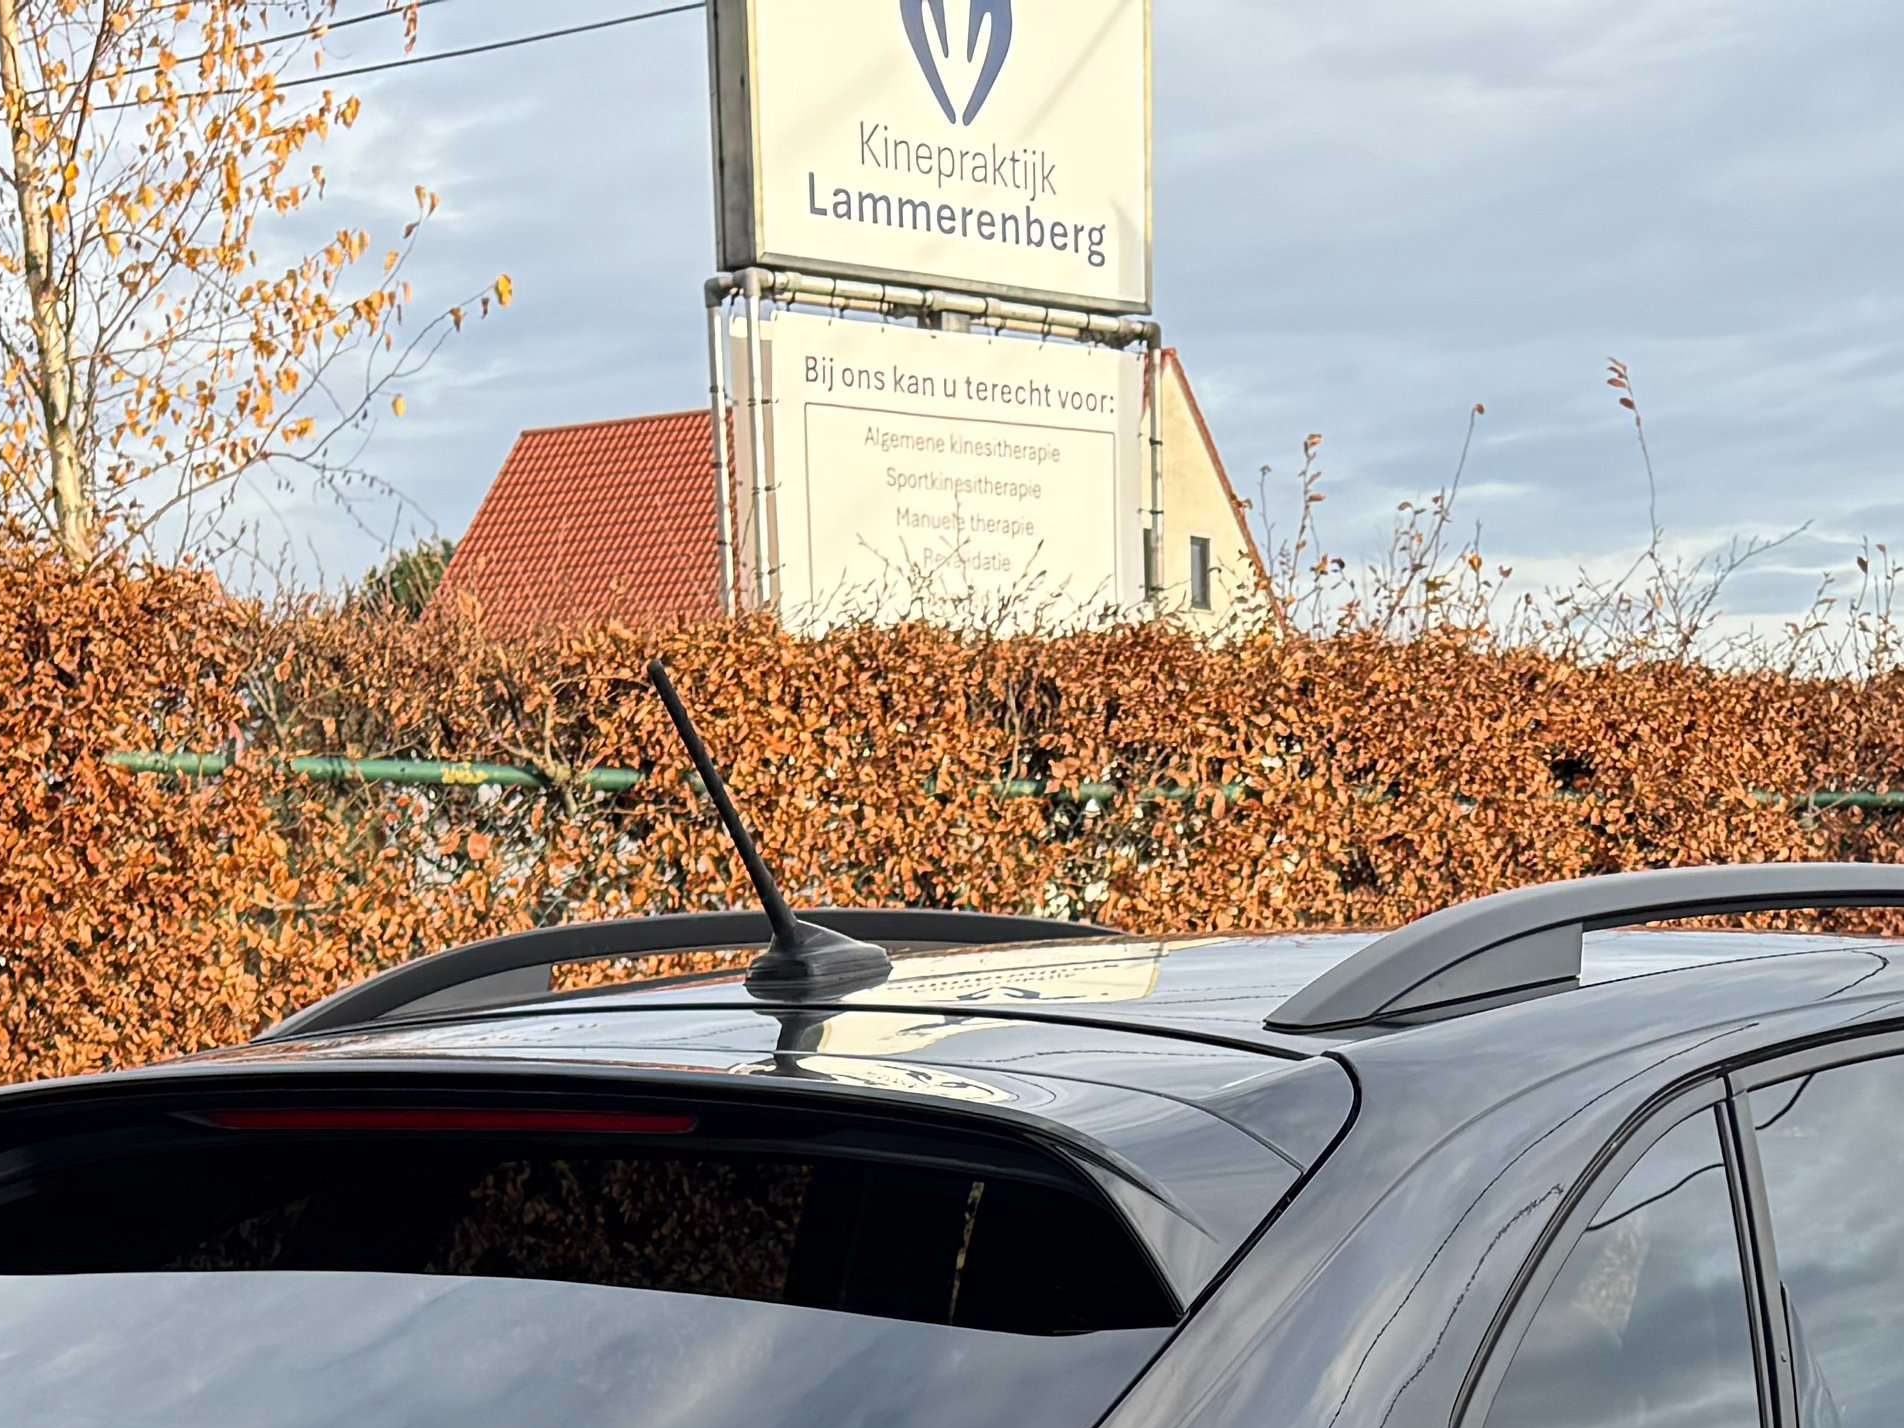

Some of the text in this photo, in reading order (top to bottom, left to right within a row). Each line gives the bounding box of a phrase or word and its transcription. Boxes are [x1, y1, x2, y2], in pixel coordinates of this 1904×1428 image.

[859, 120, 1057, 202] Kinepraktijk
[808, 171, 1106, 267] Lammerenberg
[804, 355, 1116, 414] Bij ons kan u terecht voor:
[864, 425, 1061, 465] Algemene kinesitherapie
[886, 466, 1042, 501] Sportkinesitherapie
[970, 513, 1035, 538] therapie
